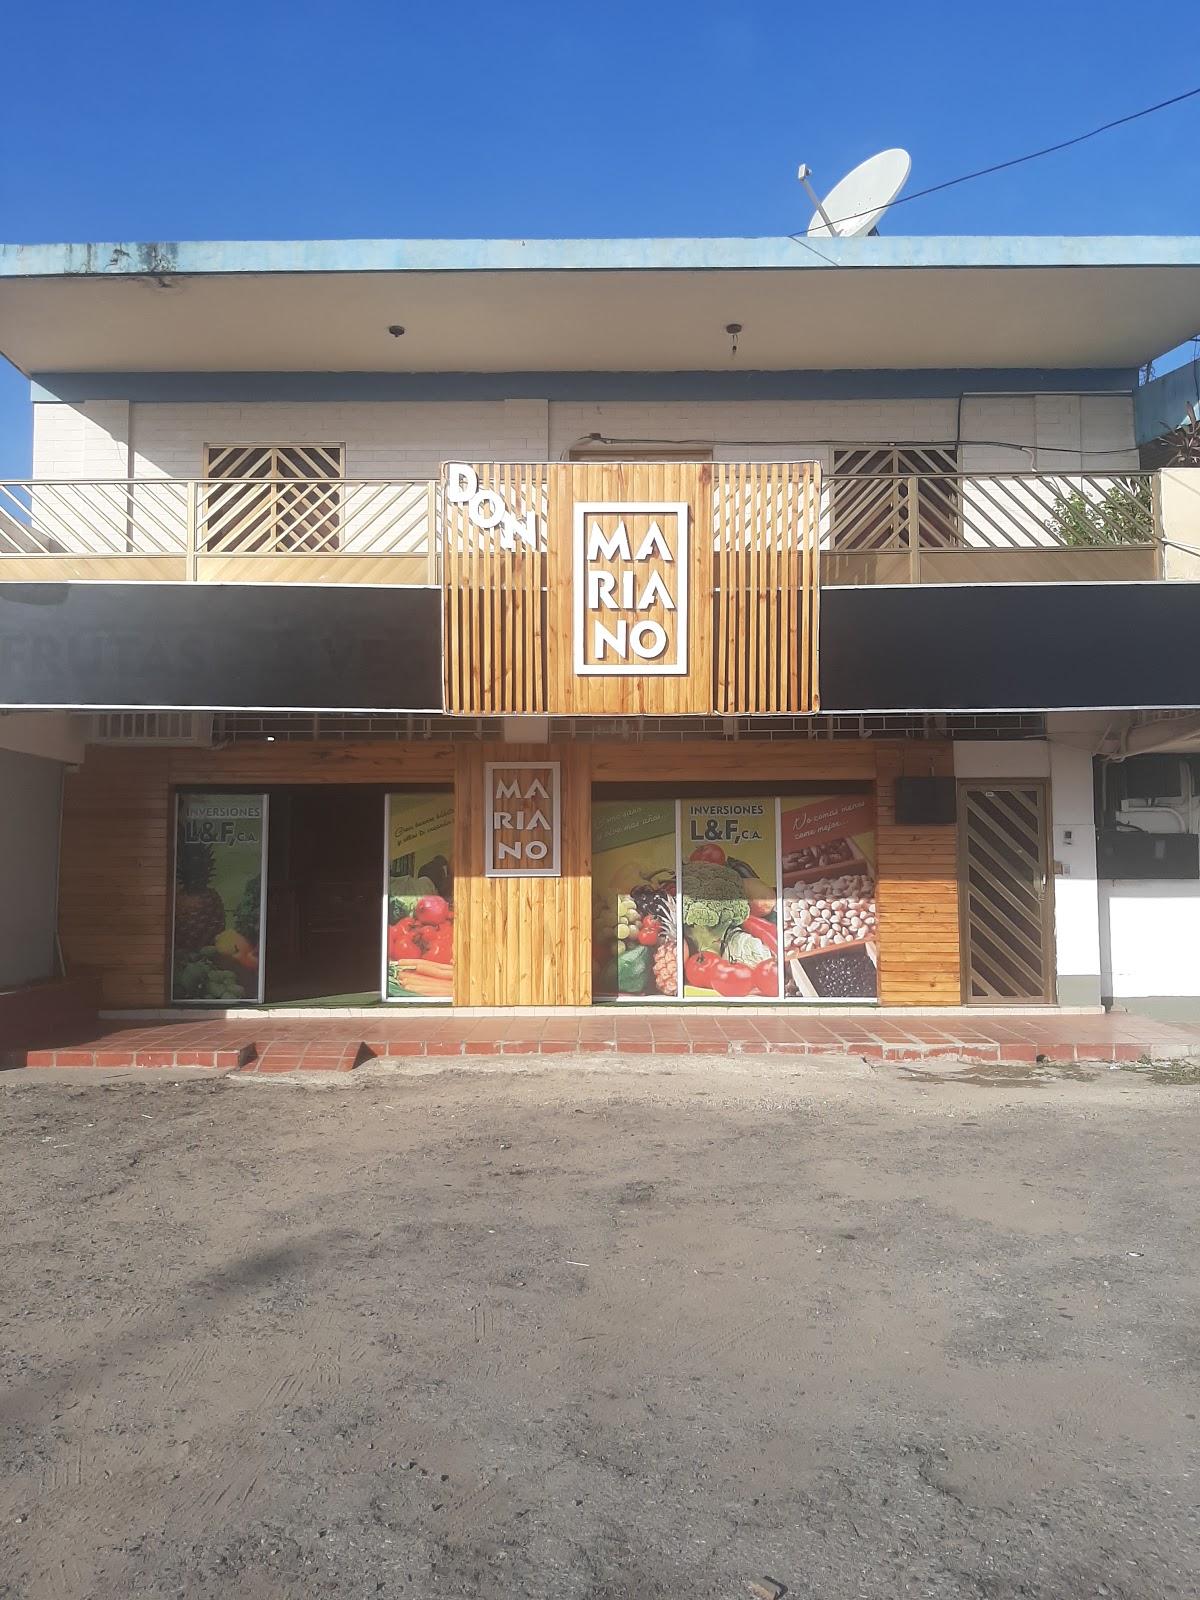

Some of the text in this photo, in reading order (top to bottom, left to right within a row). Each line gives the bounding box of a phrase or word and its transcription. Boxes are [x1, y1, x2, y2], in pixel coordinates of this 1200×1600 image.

[447, 463, 537, 551] DON
[587, 520, 674, 561] MA
[588, 569, 677, 609] RIA
[594, 620, 668, 659] NO
[495, 778, 550, 799] MA
[186, 807, 260, 817] INVERSIONES
[493, 809, 552, 830] RIA
[690, 804, 764, 815] INVERSIONES
[498, 840, 548, 860] NO
